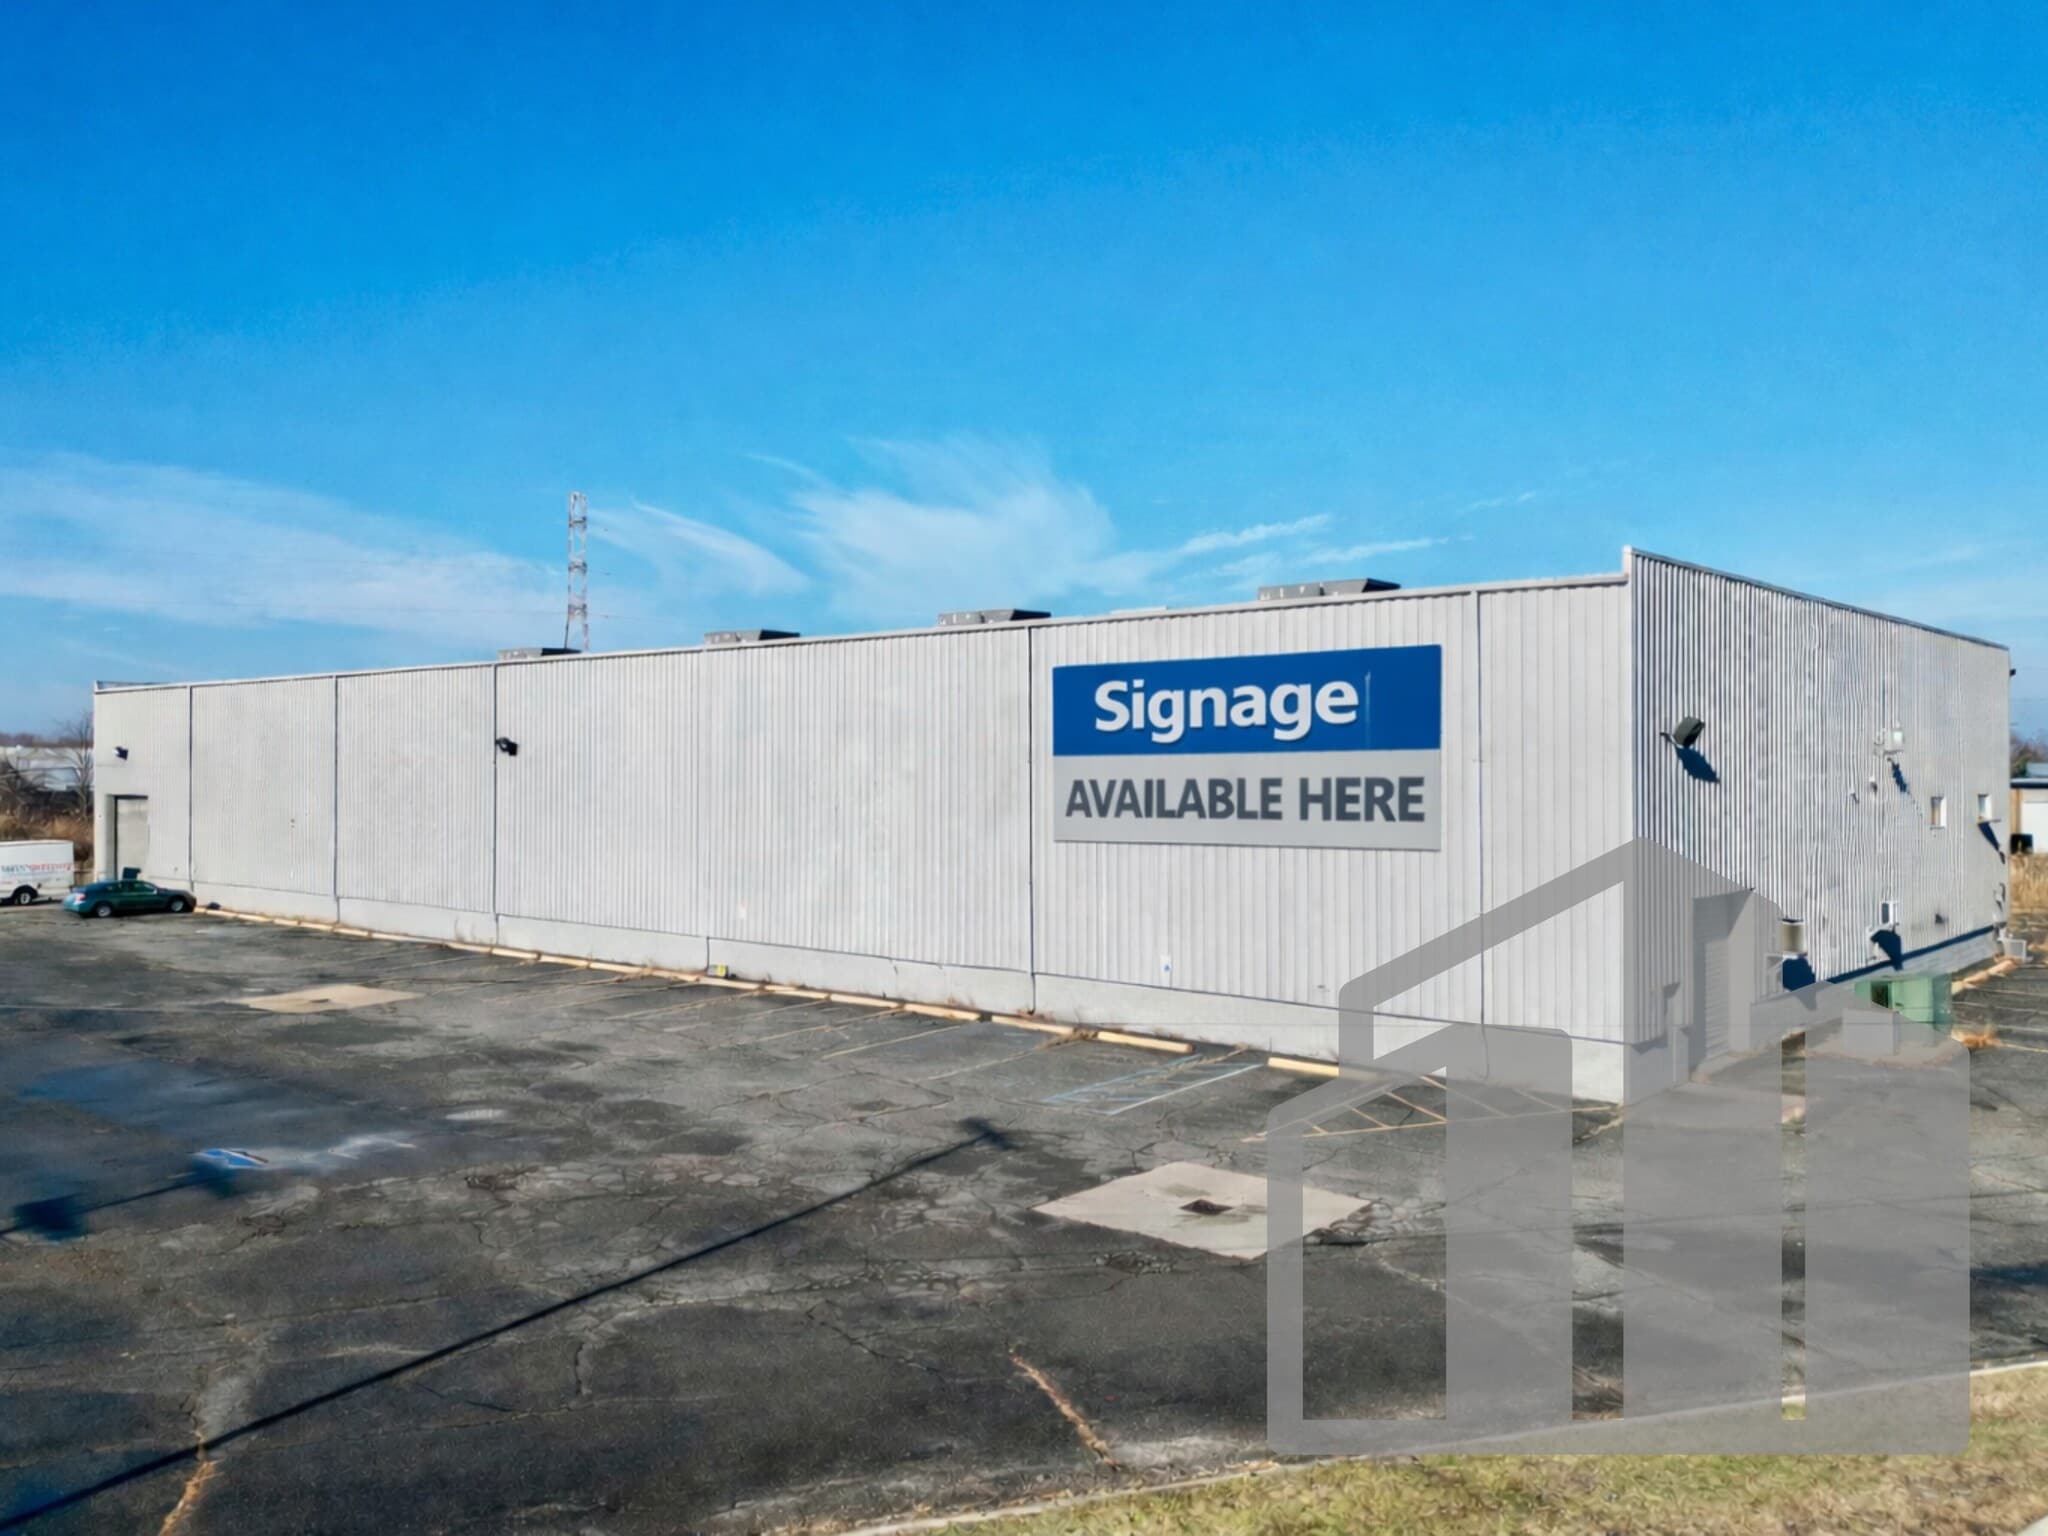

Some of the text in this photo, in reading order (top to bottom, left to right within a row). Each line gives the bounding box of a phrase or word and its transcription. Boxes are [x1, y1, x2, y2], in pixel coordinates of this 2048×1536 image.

[1095, 679, 1359, 743] Signage
[1065, 776, 1425, 822] AVAILABLE HERE
